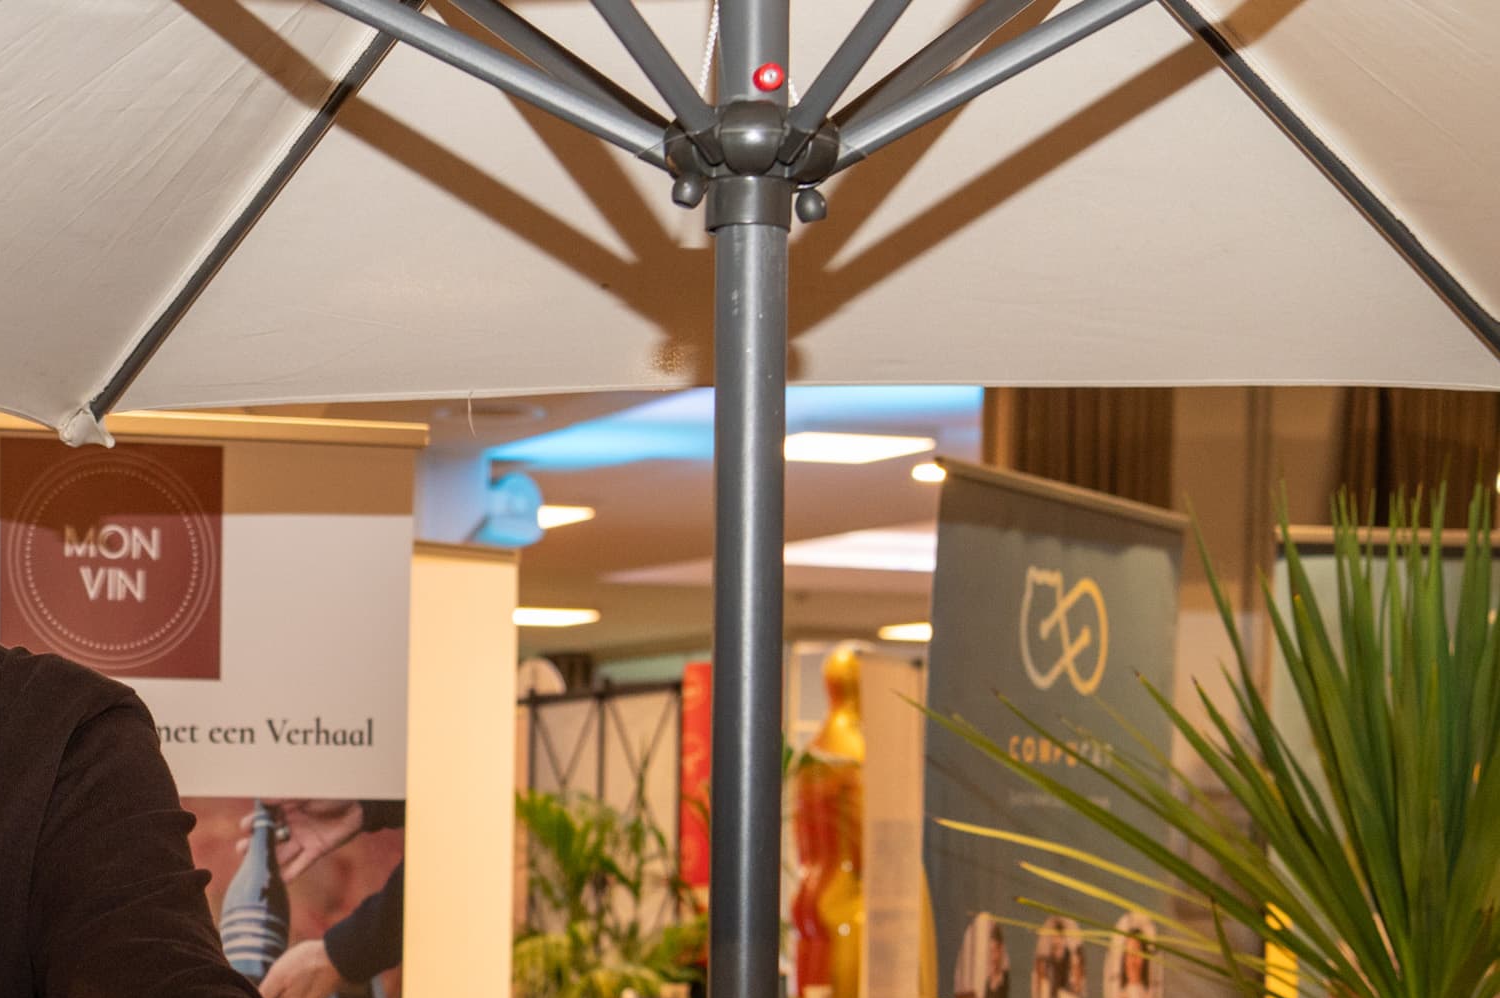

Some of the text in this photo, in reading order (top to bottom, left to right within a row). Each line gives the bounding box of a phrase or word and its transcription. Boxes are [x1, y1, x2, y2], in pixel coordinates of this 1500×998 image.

[63, 524, 161, 561] MON
[79, 566, 146, 602] VIN
[208, 726, 255, 744] een
[267, 716, 374, 747] Verhaal
